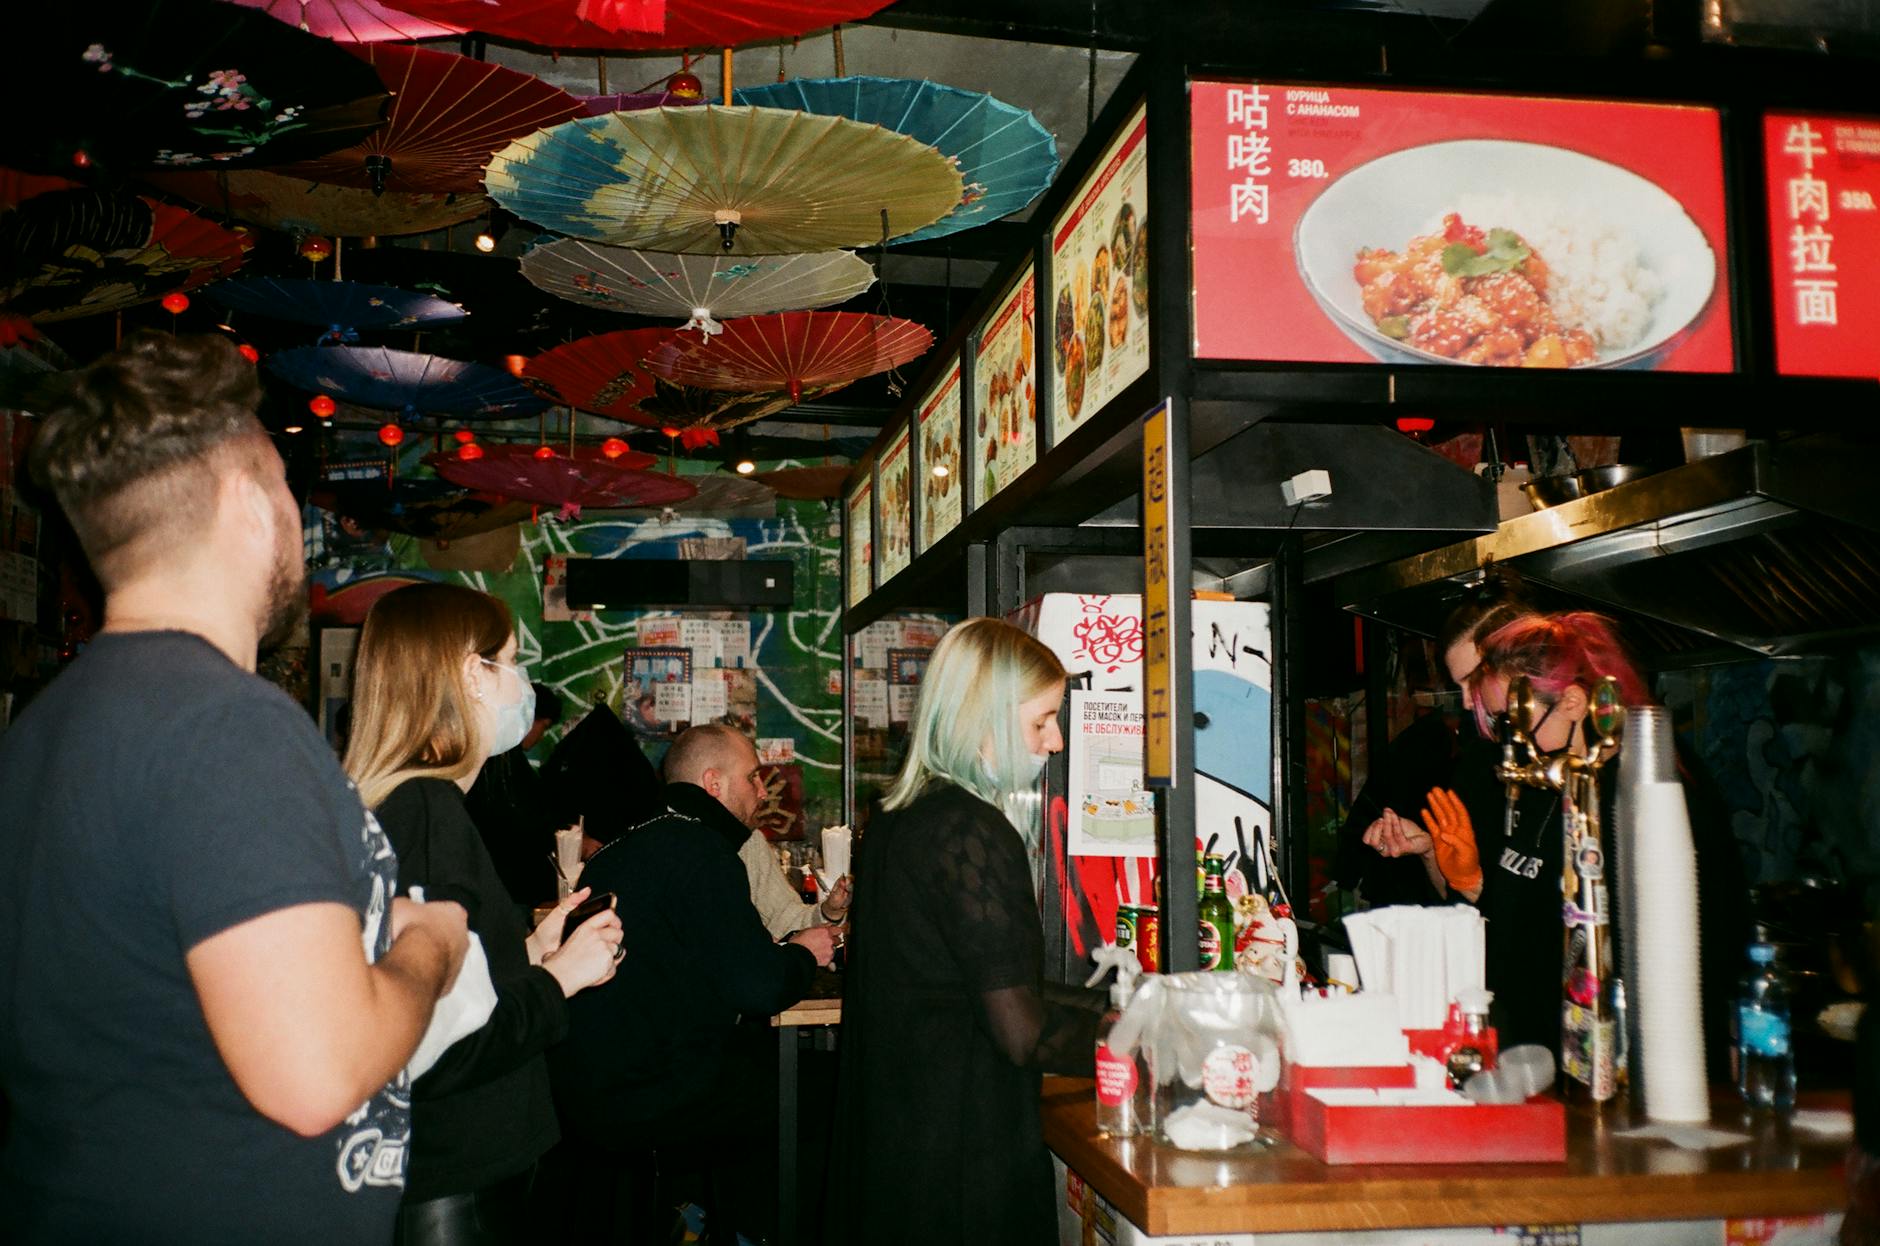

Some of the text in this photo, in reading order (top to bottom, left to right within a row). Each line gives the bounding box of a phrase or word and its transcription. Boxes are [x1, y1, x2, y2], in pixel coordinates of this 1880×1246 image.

[1286, 90, 1330, 103] КУРИЦА
[1287, 104, 1360, 117] С АНАНАСОМ
[1227, 85, 1272, 224] 咕咾肉
[1784, 120, 1839, 325] 牛肉拉面
[1083, 701, 1128, 712] ПОСЕТИТЕЛИ
[1083, 711, 1097, 721] БЕЗ
[1098, 711, 1122, 721] МАСОК
[1123, 712, 1129, 722] И
[1083, 722, 1094, 734] НЕ
